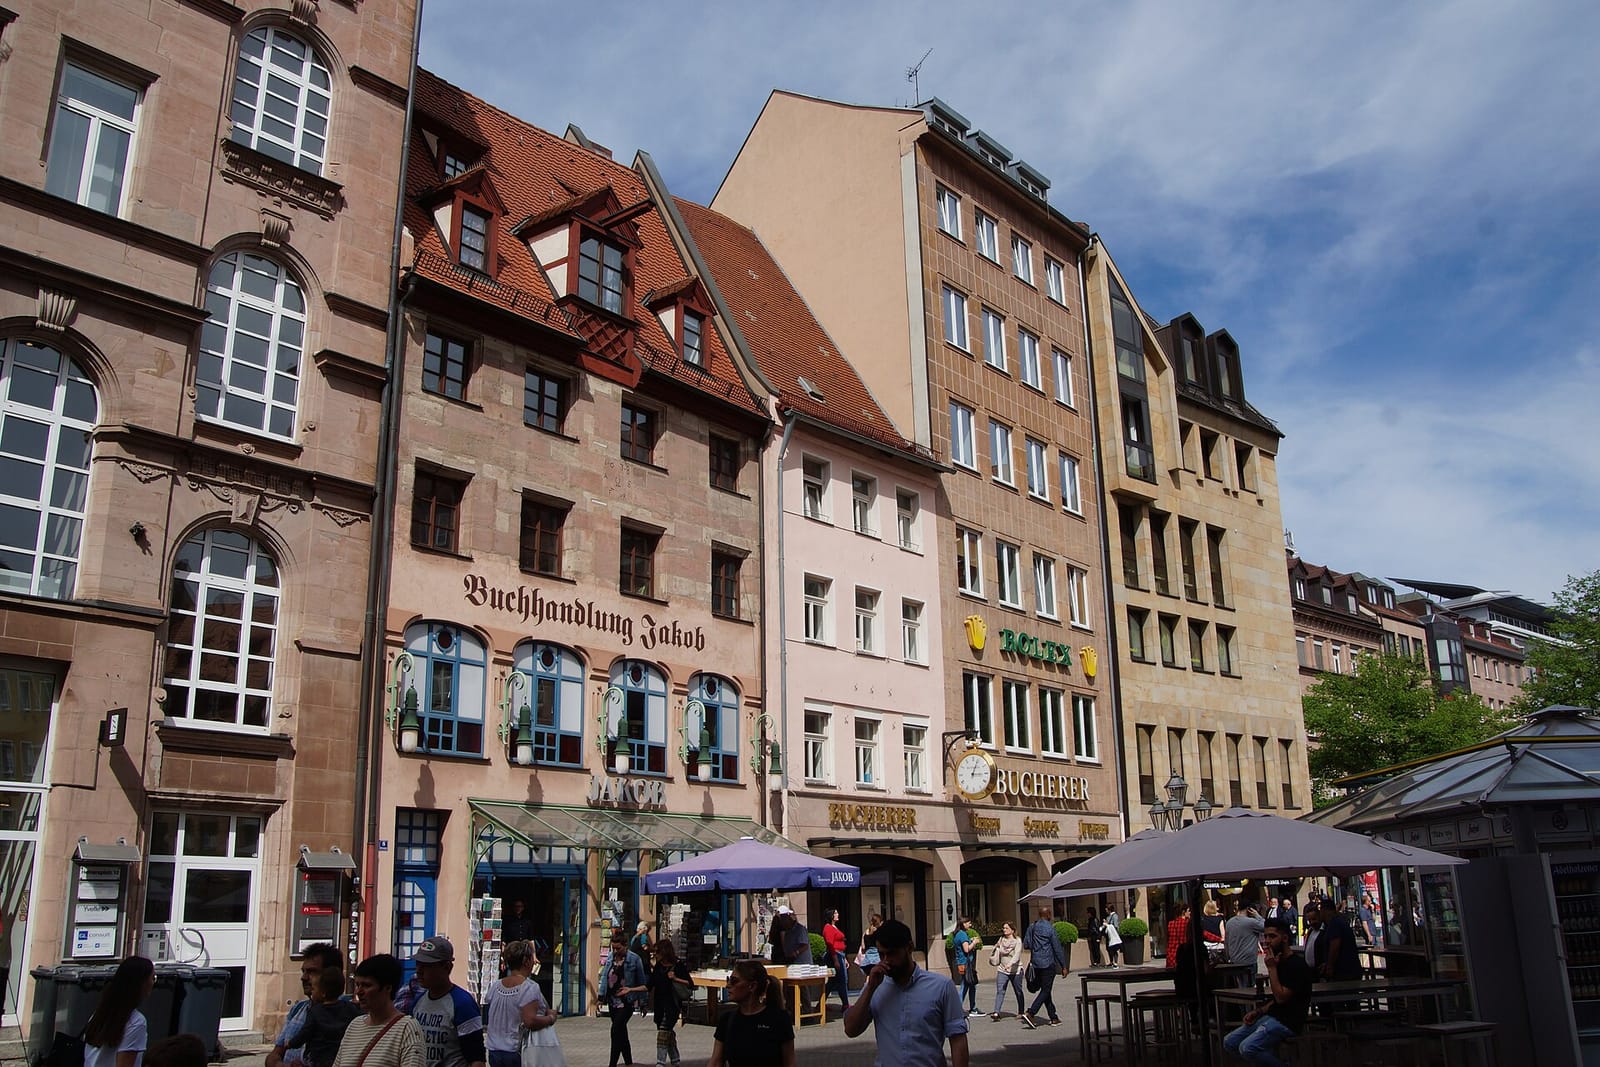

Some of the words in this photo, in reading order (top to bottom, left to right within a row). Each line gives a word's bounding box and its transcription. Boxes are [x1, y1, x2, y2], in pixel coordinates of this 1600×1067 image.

[463, 574, 633, 646] Buchhandlung
[640, 614, 705, 652] Jakob
[999, 628, 1072, 666] ROLEX
[586, 775, 667, 805] JAKOB
[996, 769, 1090, 800] BUCHERER
[828, 803, 918, 825] BUCHERER
[676, 875, 707, 888] JAKOB
[830, 872, 854, 883] JAKOB
[416, 1013, 443, 1027] MAJOR
[426, 1030, 449, 1044] ETIC
[426, 1046, 445, 1060] ION
